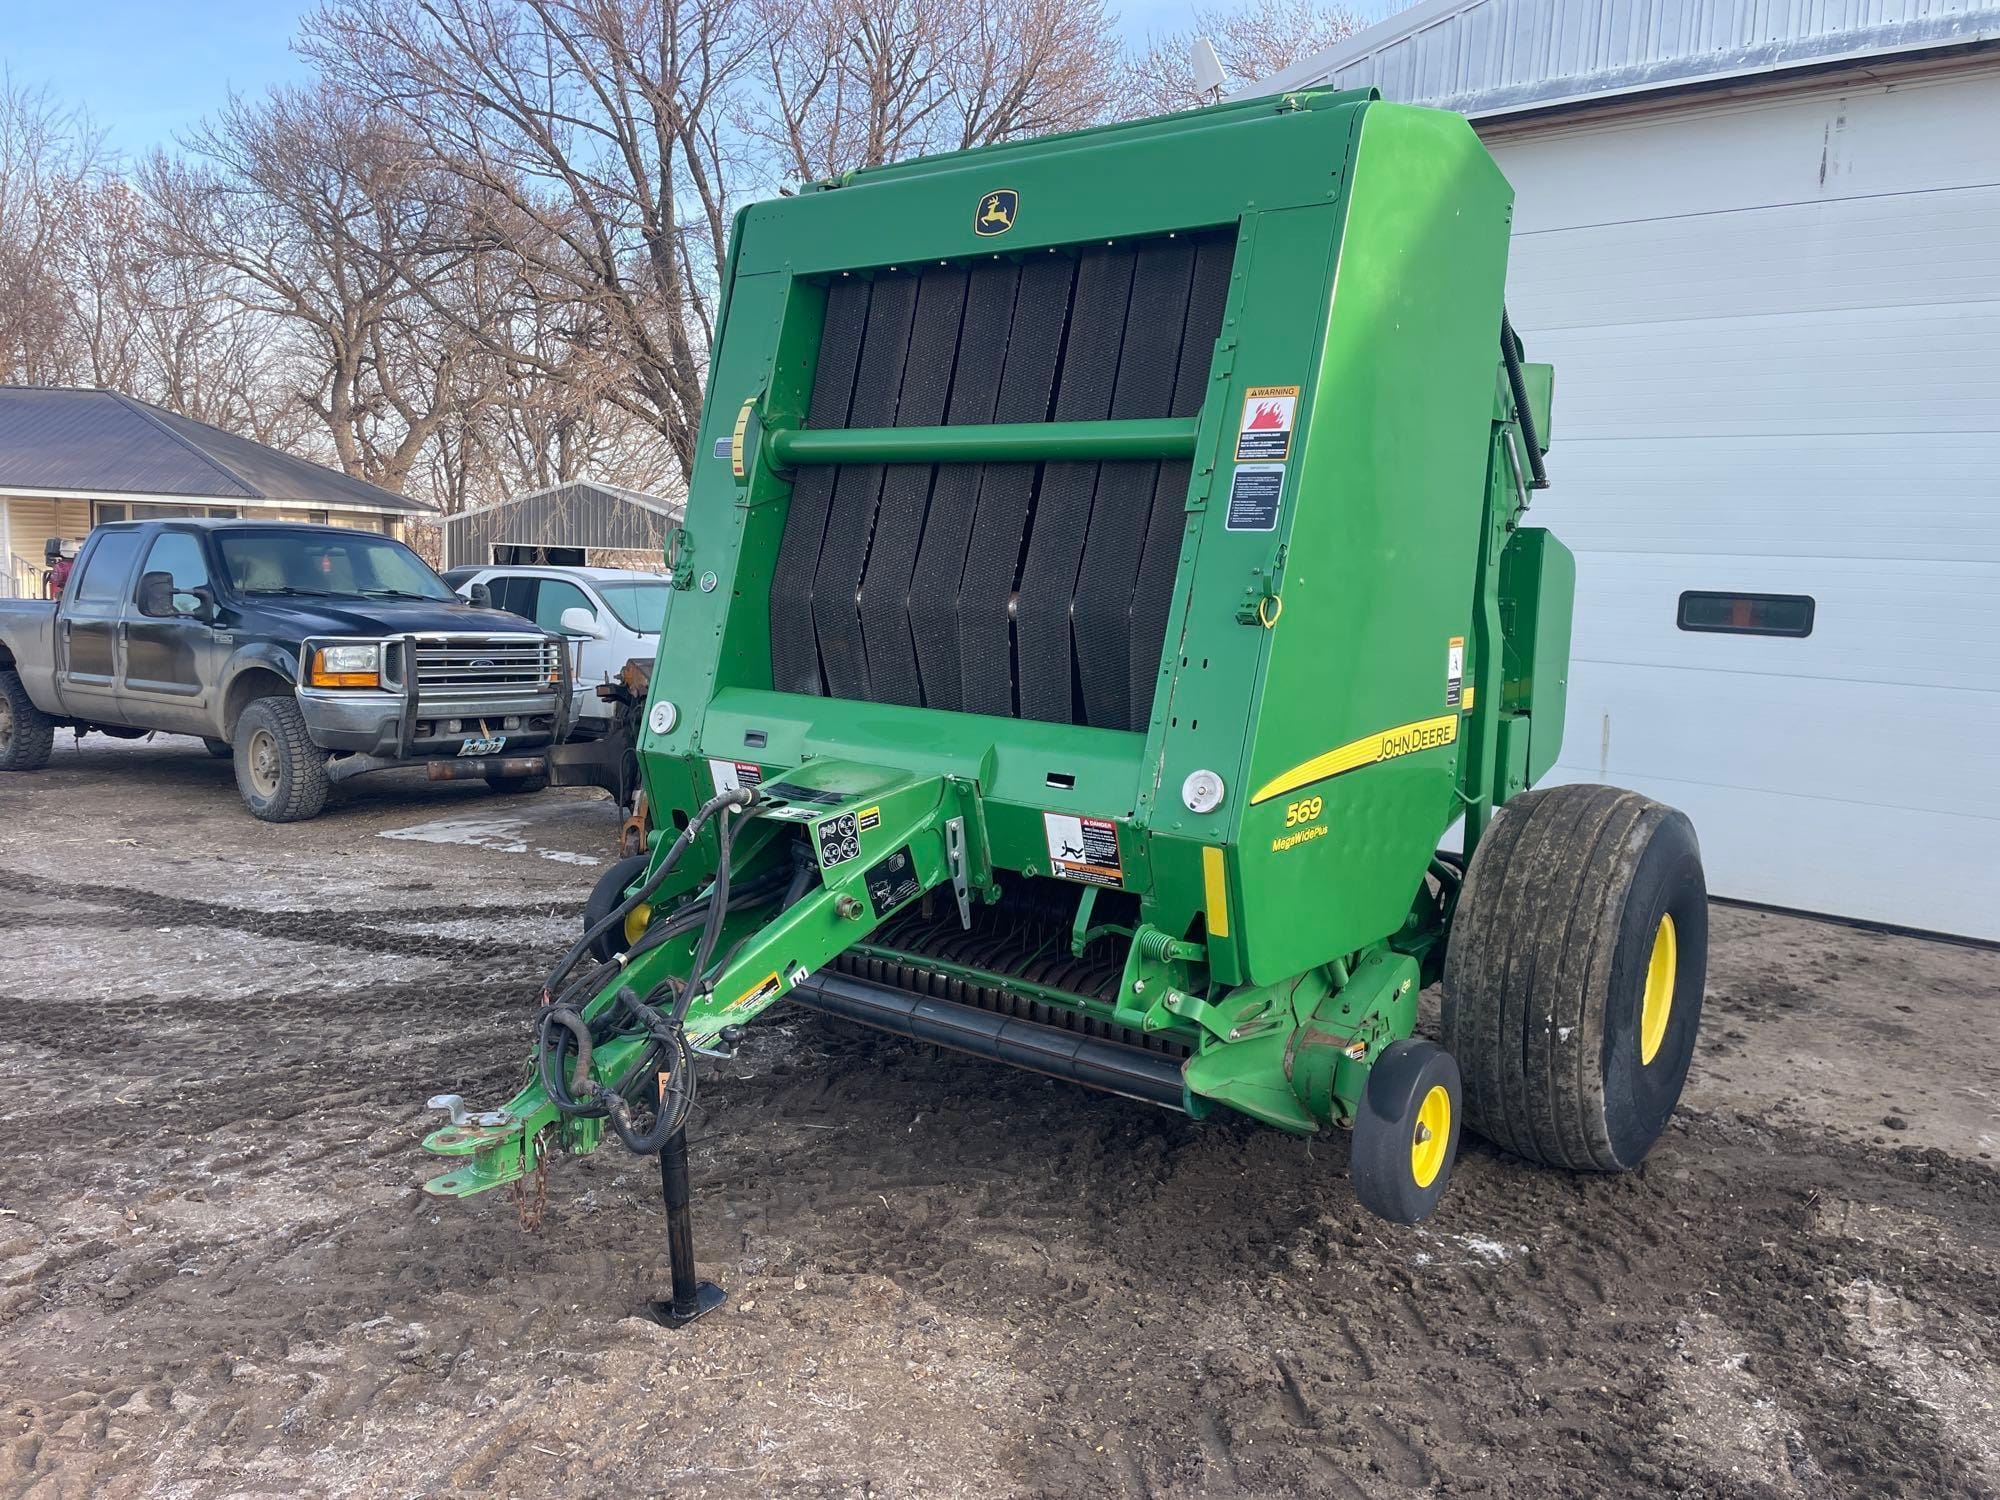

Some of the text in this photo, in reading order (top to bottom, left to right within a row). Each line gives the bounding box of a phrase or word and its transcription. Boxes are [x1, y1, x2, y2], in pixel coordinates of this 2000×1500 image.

[1257, 387, 1295, 396] WARNING
[1376, 725, 1451, 759] JOHN DEERE
[1285, 795, 1323, 828] 569
[1089, 820, 1112, 829] DANGER
